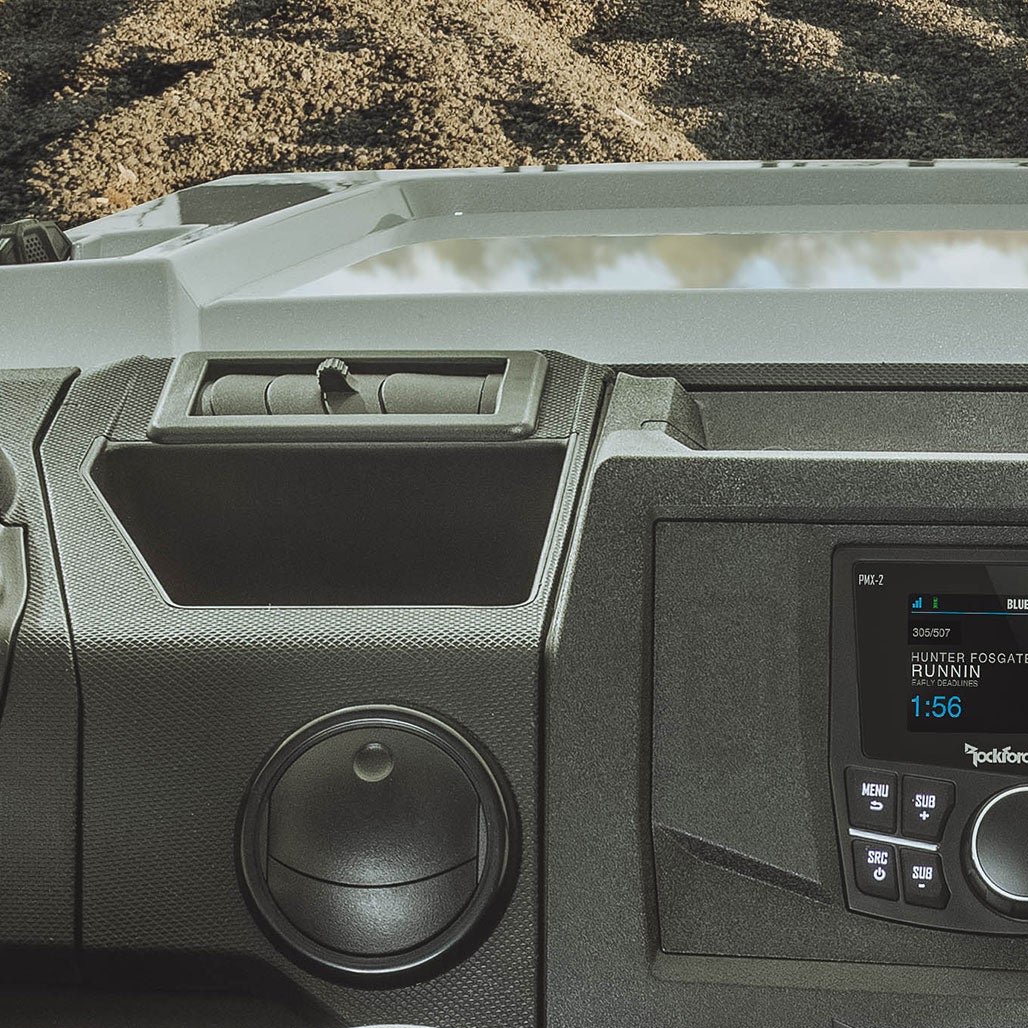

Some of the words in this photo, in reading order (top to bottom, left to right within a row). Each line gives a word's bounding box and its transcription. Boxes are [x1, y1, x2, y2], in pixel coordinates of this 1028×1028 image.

[858, 574, 884, 587] PMX-2
[912, 627, 951, 638] 305/507
[911, 651, 966, 663] HUNTER
[911, 664, 982, 678] RUNNIN
[911, 679, 935, 687] EARLY
[937, 679, 979, 688] DEADLINES
[911, 695, 962, 718] 1:56
[861, 783, 889, 798] MENU
[915, 794, 936, 808] SUB
[867, 850, 888, 865] SRC
[912, 865, 933, 880] SUB
